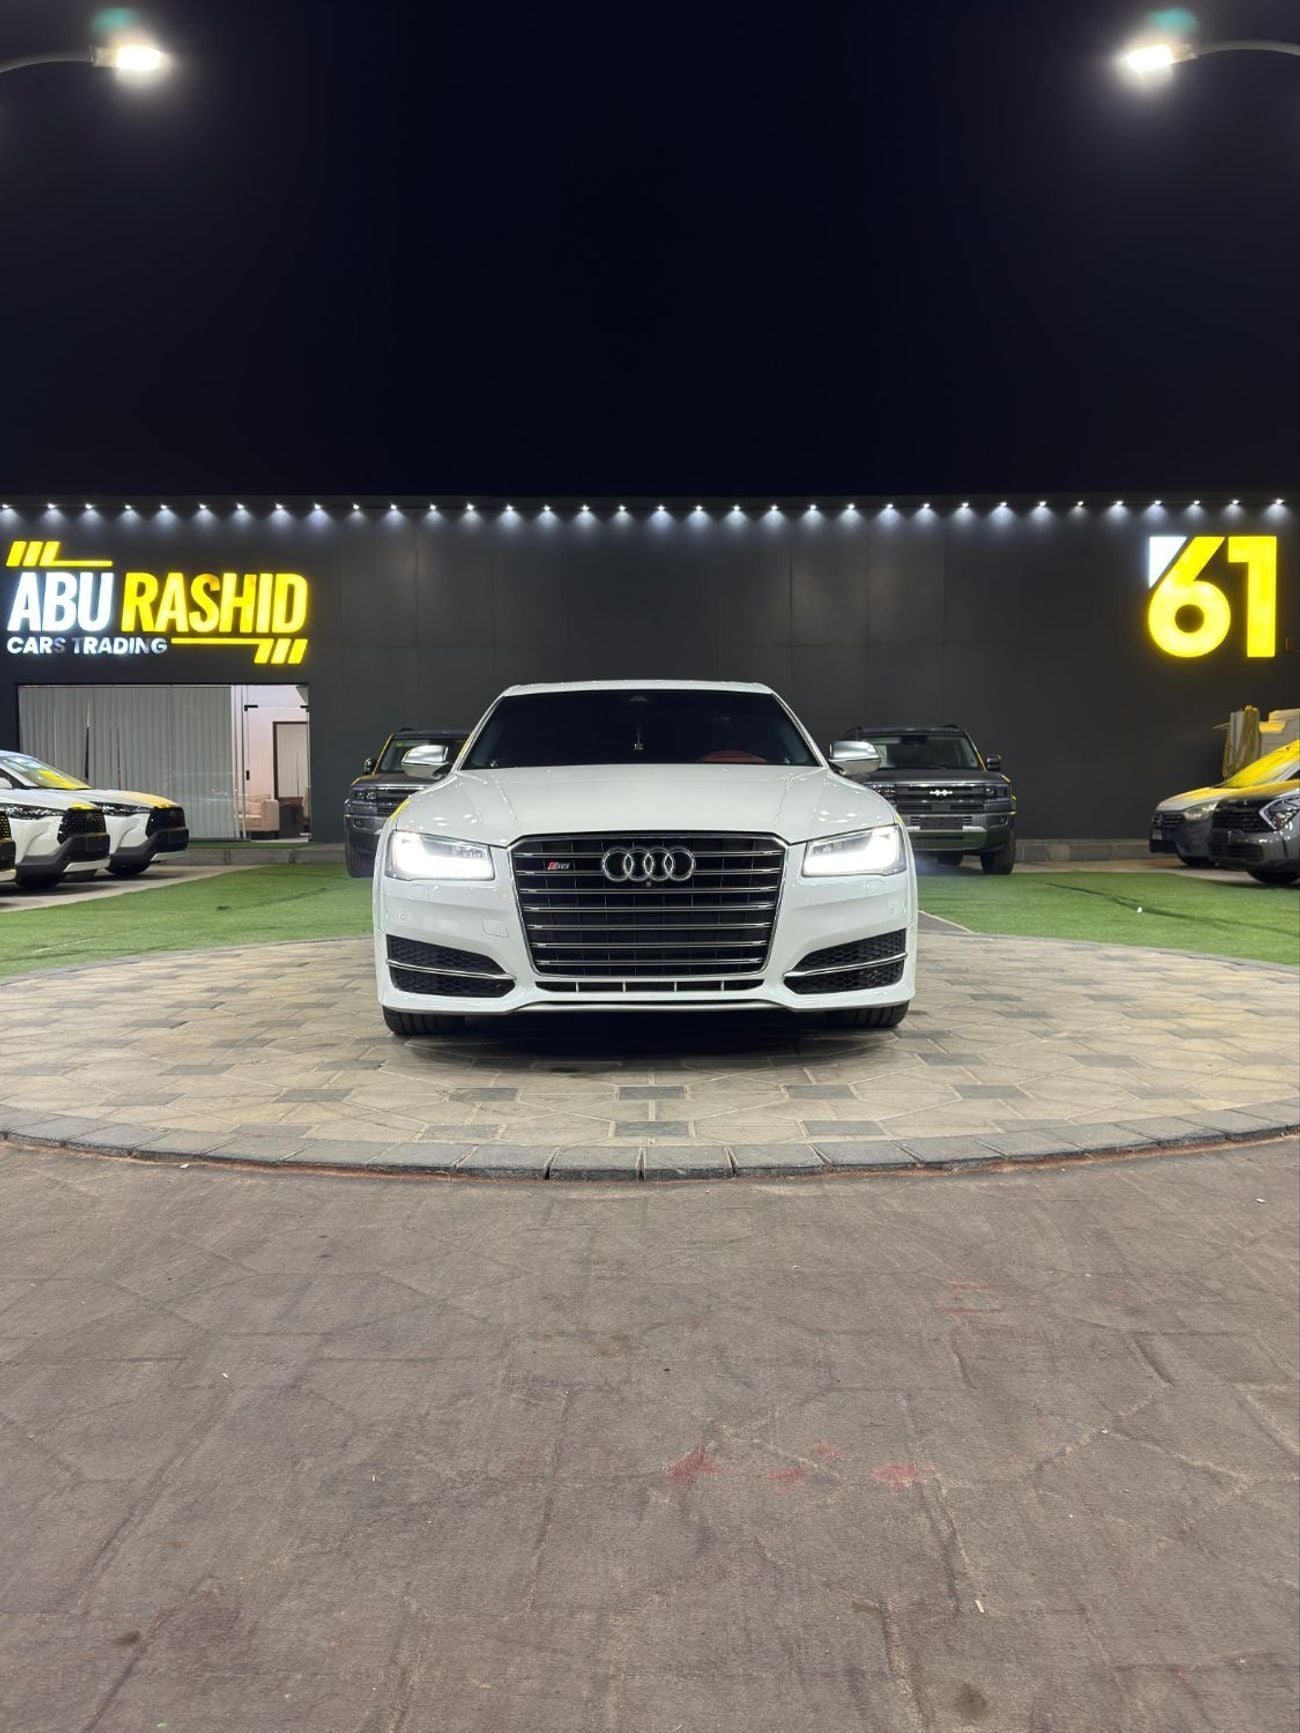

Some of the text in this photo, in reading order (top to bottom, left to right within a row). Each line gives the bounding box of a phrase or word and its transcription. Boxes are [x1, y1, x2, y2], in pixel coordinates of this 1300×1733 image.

[7, 572, 308, 633] ABU RASHID
[1148, 536, 1277, 658] 61
[7, 636, 167, 654] CARS TRADING
